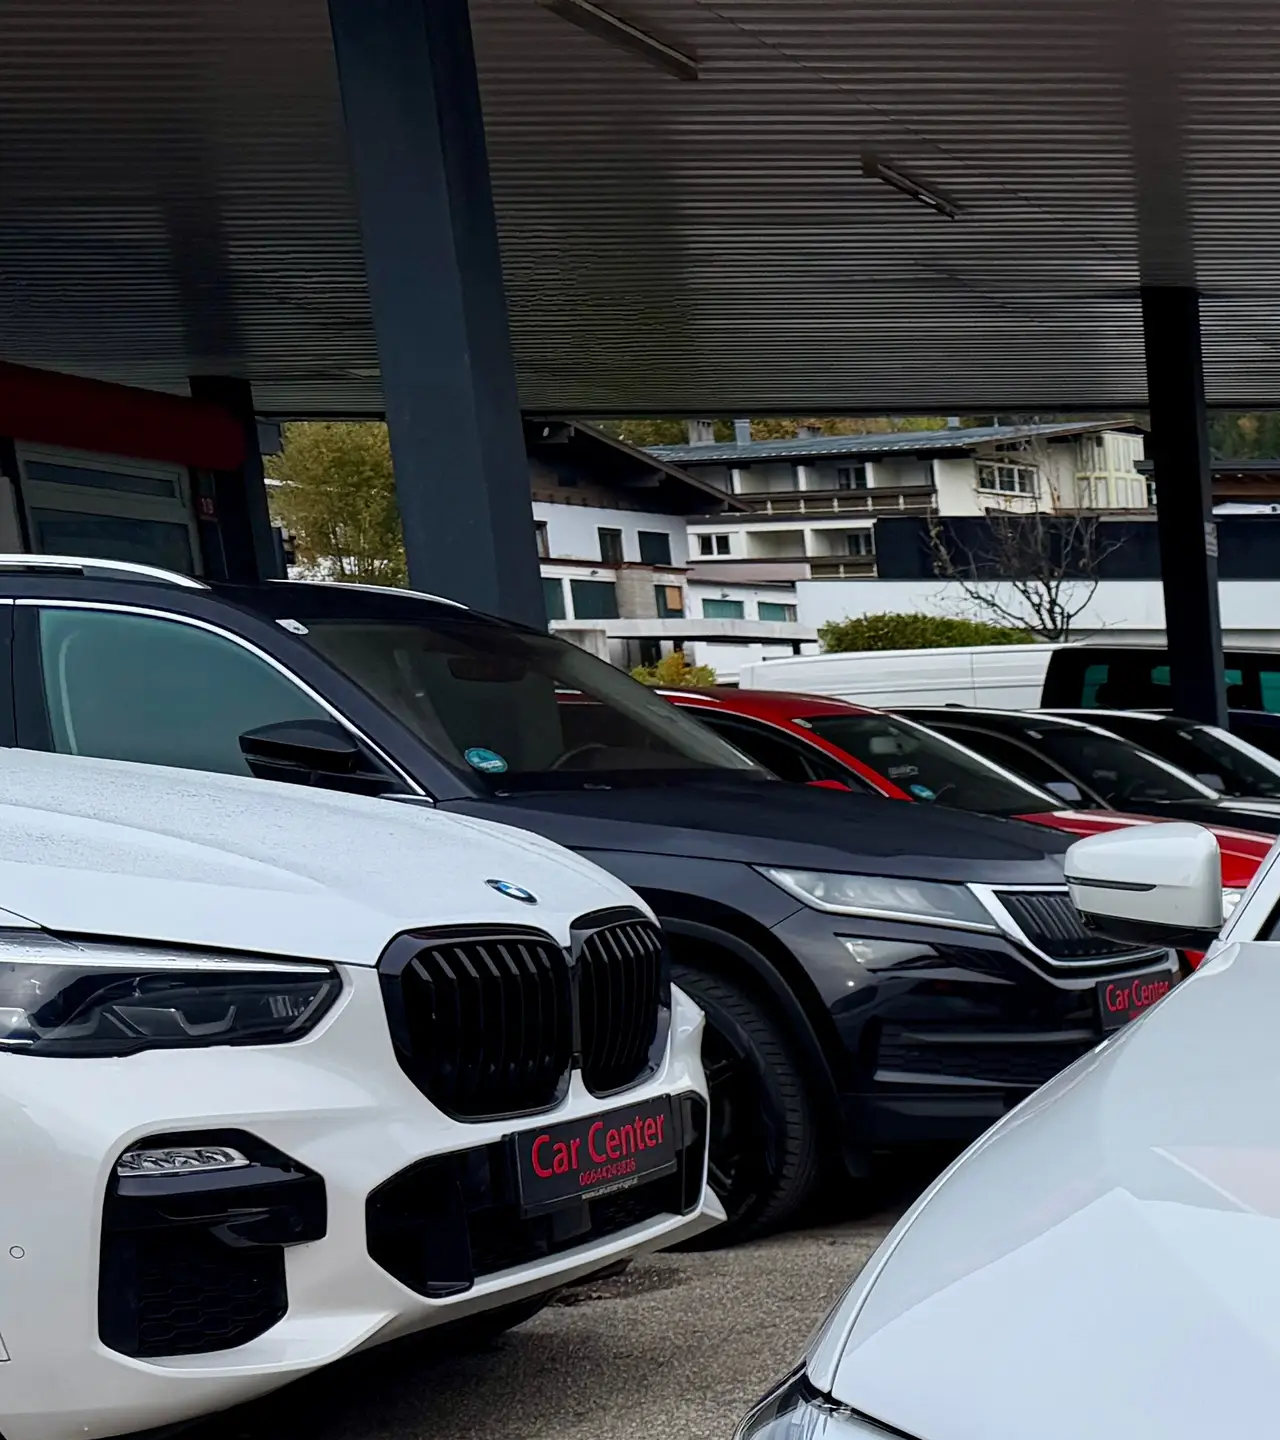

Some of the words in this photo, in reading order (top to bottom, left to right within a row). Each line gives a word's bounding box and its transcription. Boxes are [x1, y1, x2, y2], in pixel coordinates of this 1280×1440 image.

[1105, 983, 1131, 1012] Car
[531, 1134, 581, 1179] Car
[588, 1114, 664, 1164] Center
